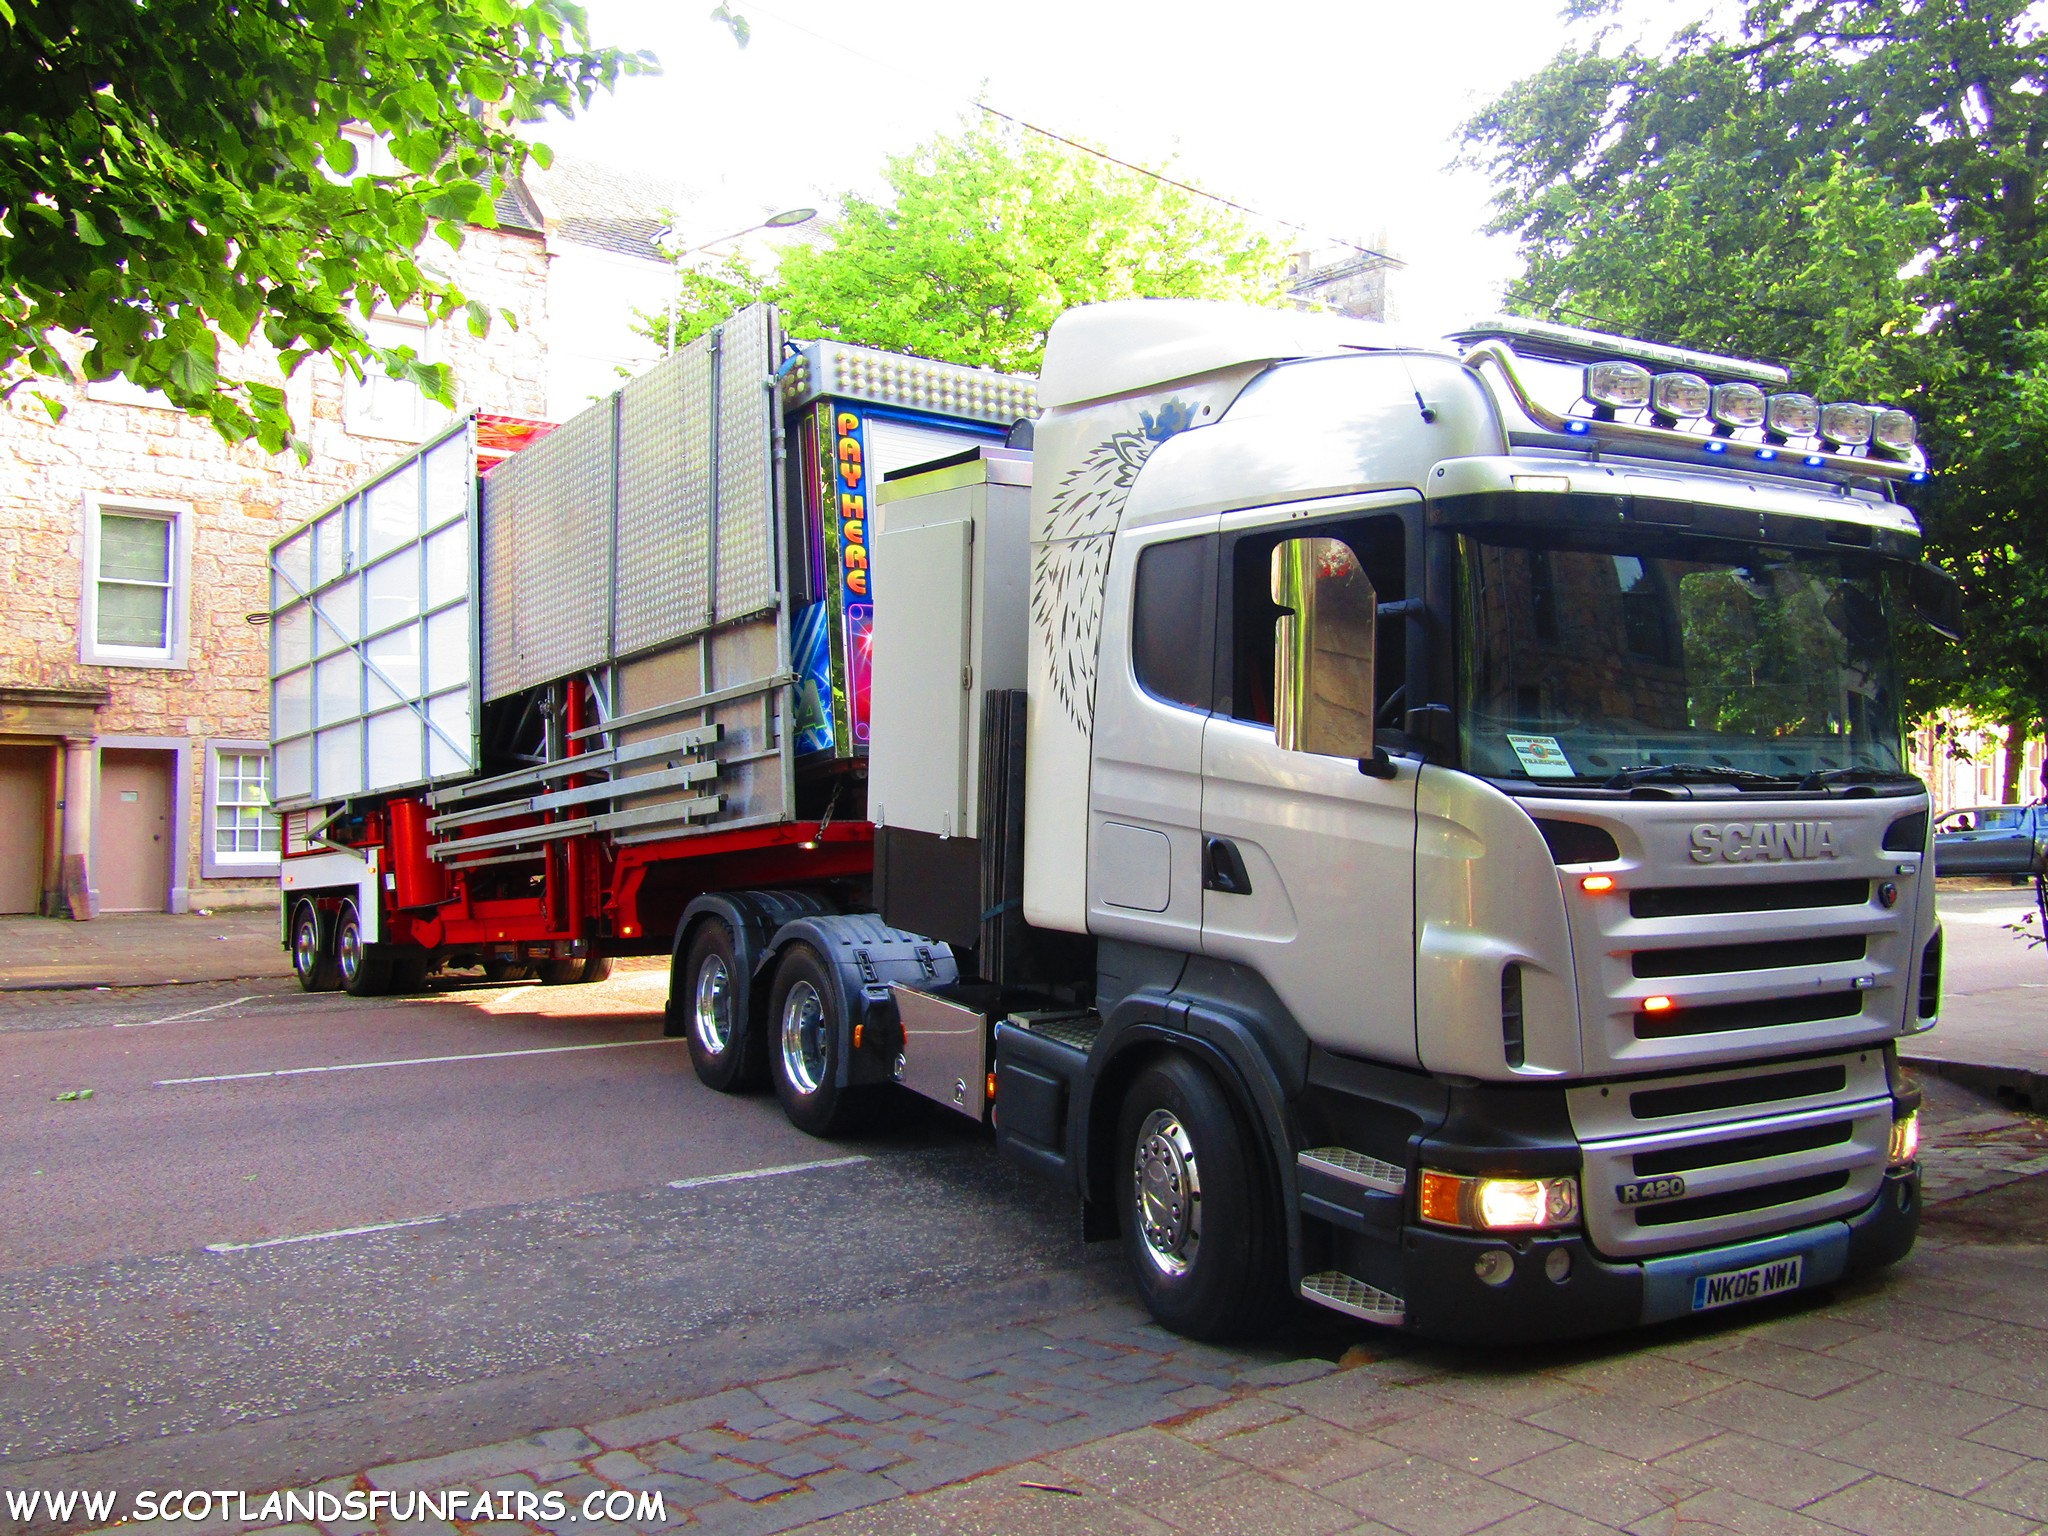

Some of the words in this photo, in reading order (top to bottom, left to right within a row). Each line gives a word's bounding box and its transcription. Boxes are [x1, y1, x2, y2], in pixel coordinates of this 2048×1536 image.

[837, 412, 862, 487] PAY
[841, 493, 867, 595] HERE
[1690, 823, 1839, 863] SCANIA
[1624, 1184, 1638, 1202] R
[1641, 1178, 1683, 1198] 420
[1707, 1270, 1760, 1304] NK06
[1763, 1261, 1797, 1291] NWA
